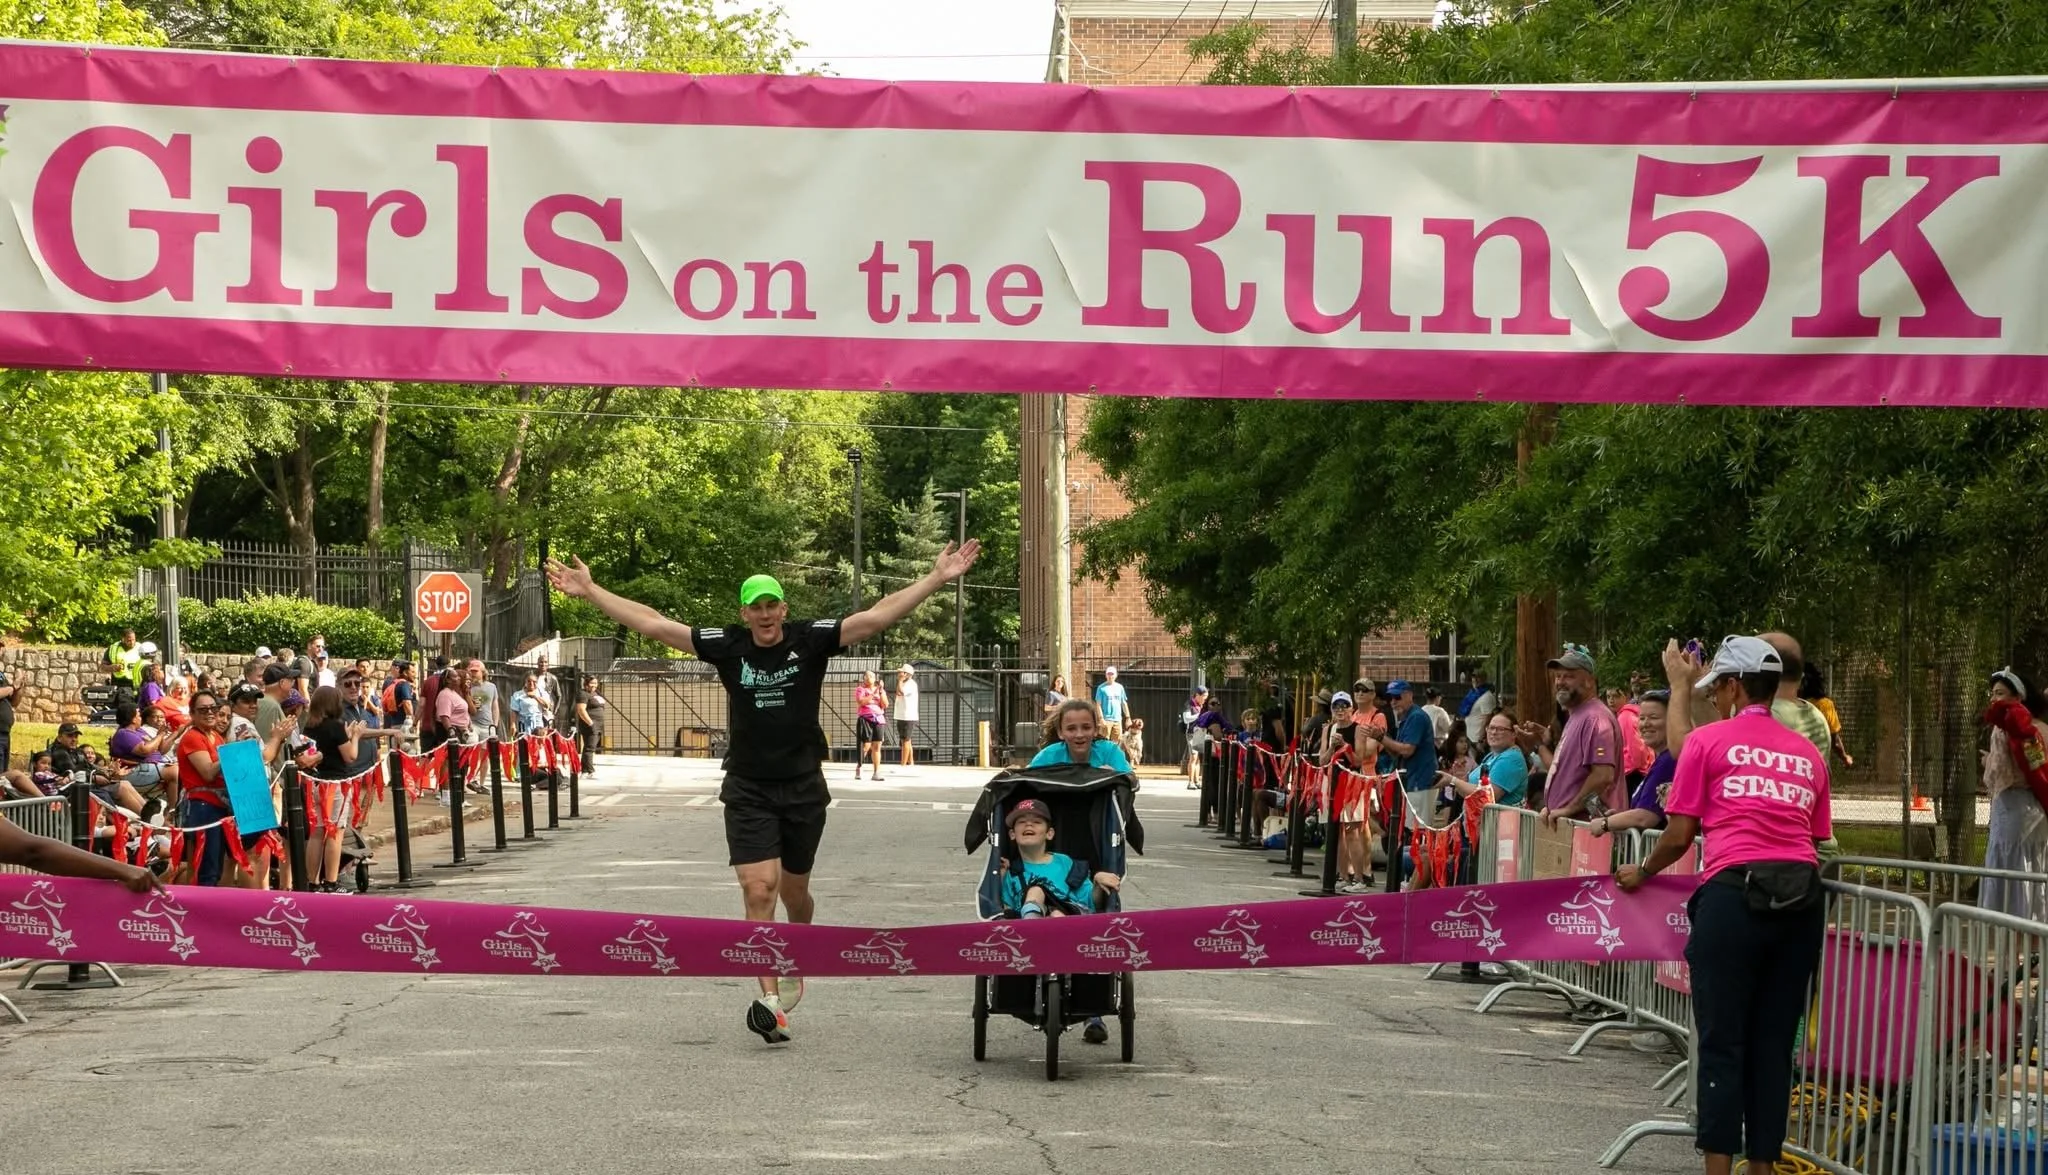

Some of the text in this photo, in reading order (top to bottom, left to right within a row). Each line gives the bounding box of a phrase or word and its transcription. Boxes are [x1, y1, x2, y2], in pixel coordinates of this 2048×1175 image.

[32, 124, 2002, 342] Girls on the Run 5K
[420, 591, 467, 613] STOP
[773, 665, 799, 679] PEASE
[1727, 744, 1814, 780] GOTR
[1723, 775, 1814, 809] STAFF
[0, 911, 38, 926] Girls
[1547, 912, 1587, 926] Girls
[20, 924, 49, 936] run
[118, 919, 159, 933] Girls
[1431, 919, 1470, 931] Girls
[1567, 924, 1598, 935] run
[140, 930, 171, 942] run
[241, 925, 281, 939] Girls
[1311, 929, 1350, 940] Girls
[1450, 928, 1480, 938] run
[262, 937, 293, 947] run
[361, 932, 402, 945] Girls
[1194, 936, 1233, 947] Girls
[1330, 936, 1359, 946] run
[382, 944, 414, 953] run
[482, 939, 522, 951] Girls
[602, 944, 641, 955] Girls
[1077, 942, 1117, 953] Girls
[1214, 943, 1243, 953] run
[502, 948, 534, 958] run
[622, 953, 653, 962] run
[721, 949, 761, 959] Girls
[840, 950, 879, 959] Girls
[959, 948, 998, 957] Girls
[1096, 950, 1126, 959] run
